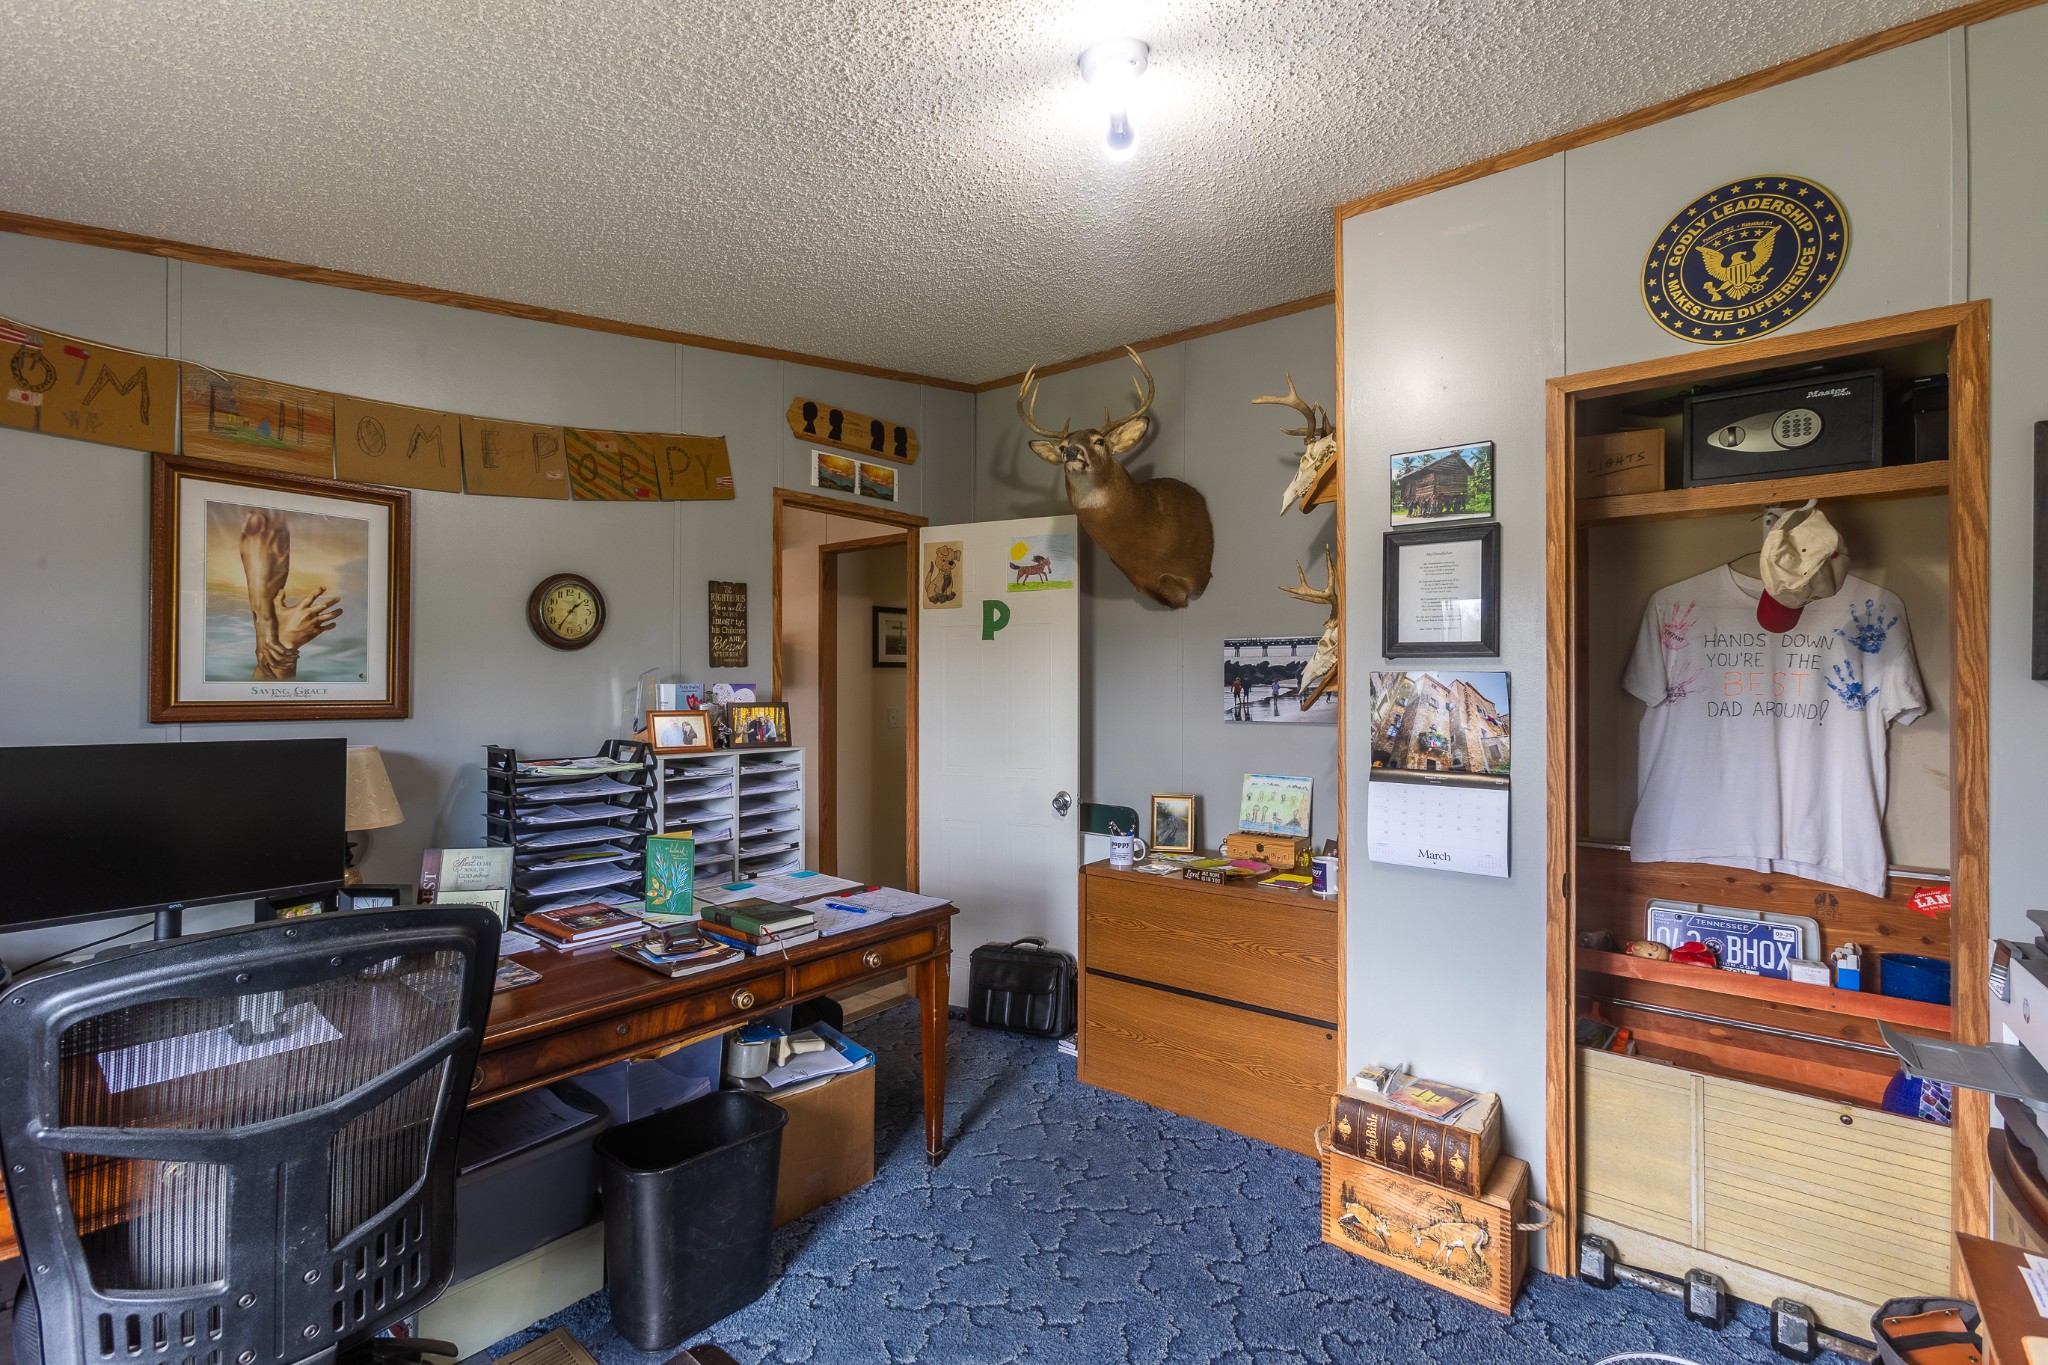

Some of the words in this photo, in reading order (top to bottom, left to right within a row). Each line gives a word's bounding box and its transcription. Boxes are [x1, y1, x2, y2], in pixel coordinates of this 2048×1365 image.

[1668, 218, 1708, 267] GODLY
[1712, 198, 1814, 232] LEADERSHIP
[1667, 279, 1702, 316] MAKES
[1702, 309, 1734, 321] THE
[1738, 246, 1816, 319] DIFFERENCE
[1806, 388, 1847, 398] Master
[1587, 452, 1645, 474] LIGHTS
[710, 593, 746, 602] RIGHTEOUS
[982, 600, 1010, 640] P
[1704, 634, 1766, 648] HANDS
[1781, 634, 1834, 649] DOWN
[1706, 653, 1764, 667] YOU'RE
[1787, 654, 1822, 670] THE
[251, 686, 290, 695] SAVING
[294, 686, 328, 695] GRACE
[1724, 672, 1810, 696] BEST
[1707, 701, 1742, 718] DAD
[1752, 700, 1829, 726] AROUND!
[1418, 848, 1452, 862] March
[1914, 890, 1941, 898] Genuine
[1914, 893, 1951, 908] LAN
[1696, 919, 1749, 931] TENNESSEE
[1727, 935, 1792, 970] BHQX
[1366, 1114, 1378, 1139] Bible
